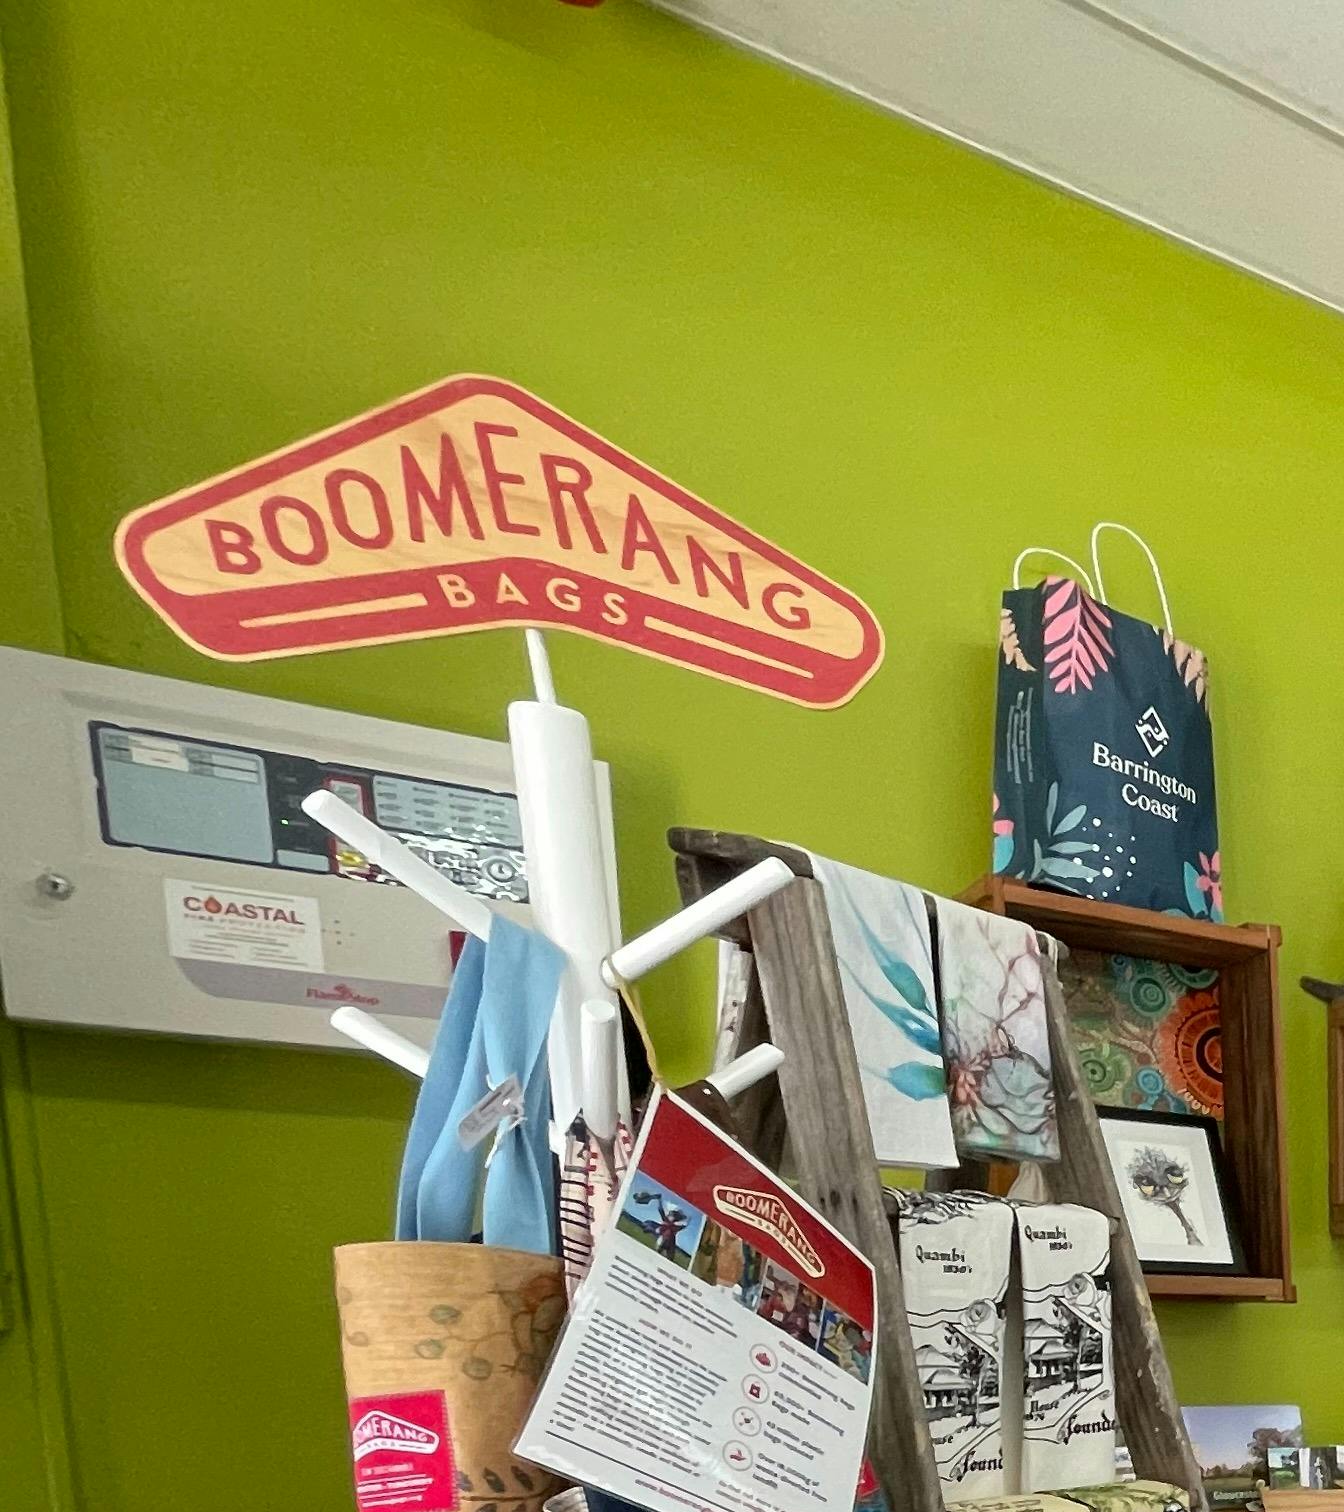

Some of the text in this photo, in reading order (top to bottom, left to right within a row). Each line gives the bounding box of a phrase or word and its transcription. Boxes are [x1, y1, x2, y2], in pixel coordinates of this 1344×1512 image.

[207, 421, 812, 632] BOOMERANG
[437, 573, 630, 626] BAGS
[1091, 740, 1198, 806] Barrington
[1120, 781, 1180, 824] Coast
[726, 1191, 816, 1265] BOOMERANG
